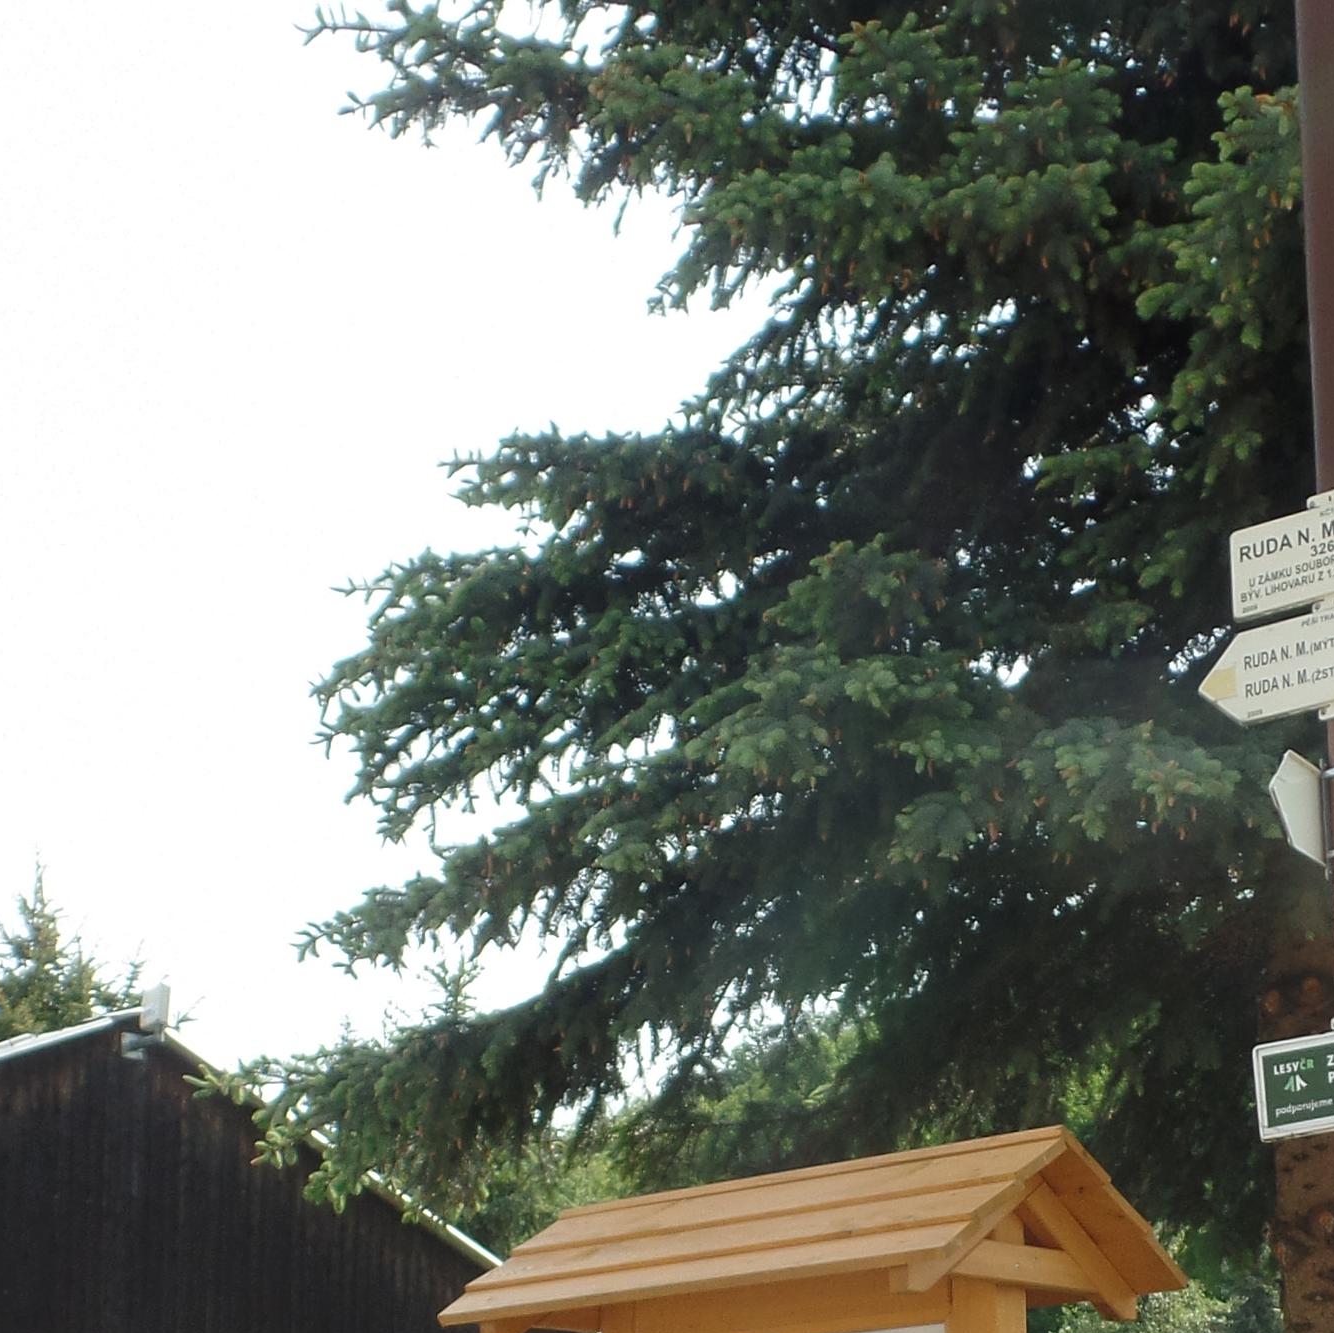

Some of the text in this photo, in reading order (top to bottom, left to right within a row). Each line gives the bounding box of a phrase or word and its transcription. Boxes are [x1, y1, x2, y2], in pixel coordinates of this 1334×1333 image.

[1239, 534, 1292, 563] RUDA
[1298, 528, 1315, 546] N.
[1310, 543, 1334, 557] 326
[1249, 578, 1255, 587] U
[1258, 566, 1292, 585] ZÁMKU
[1265, 576, 1315, 596] LIHOVARU
[1318, 571, 1323, 581] Z
[1327, 569, 1334, 578] 1.
[1243, 649, 1278, 671] RUDA
[1280, 645, 1292, 660] N.
[1245, 676, 1279, 698] RUDA
[1282, 673, 1294, 689] N.
[1275, 1098, 1333, 1118] podporujeme
